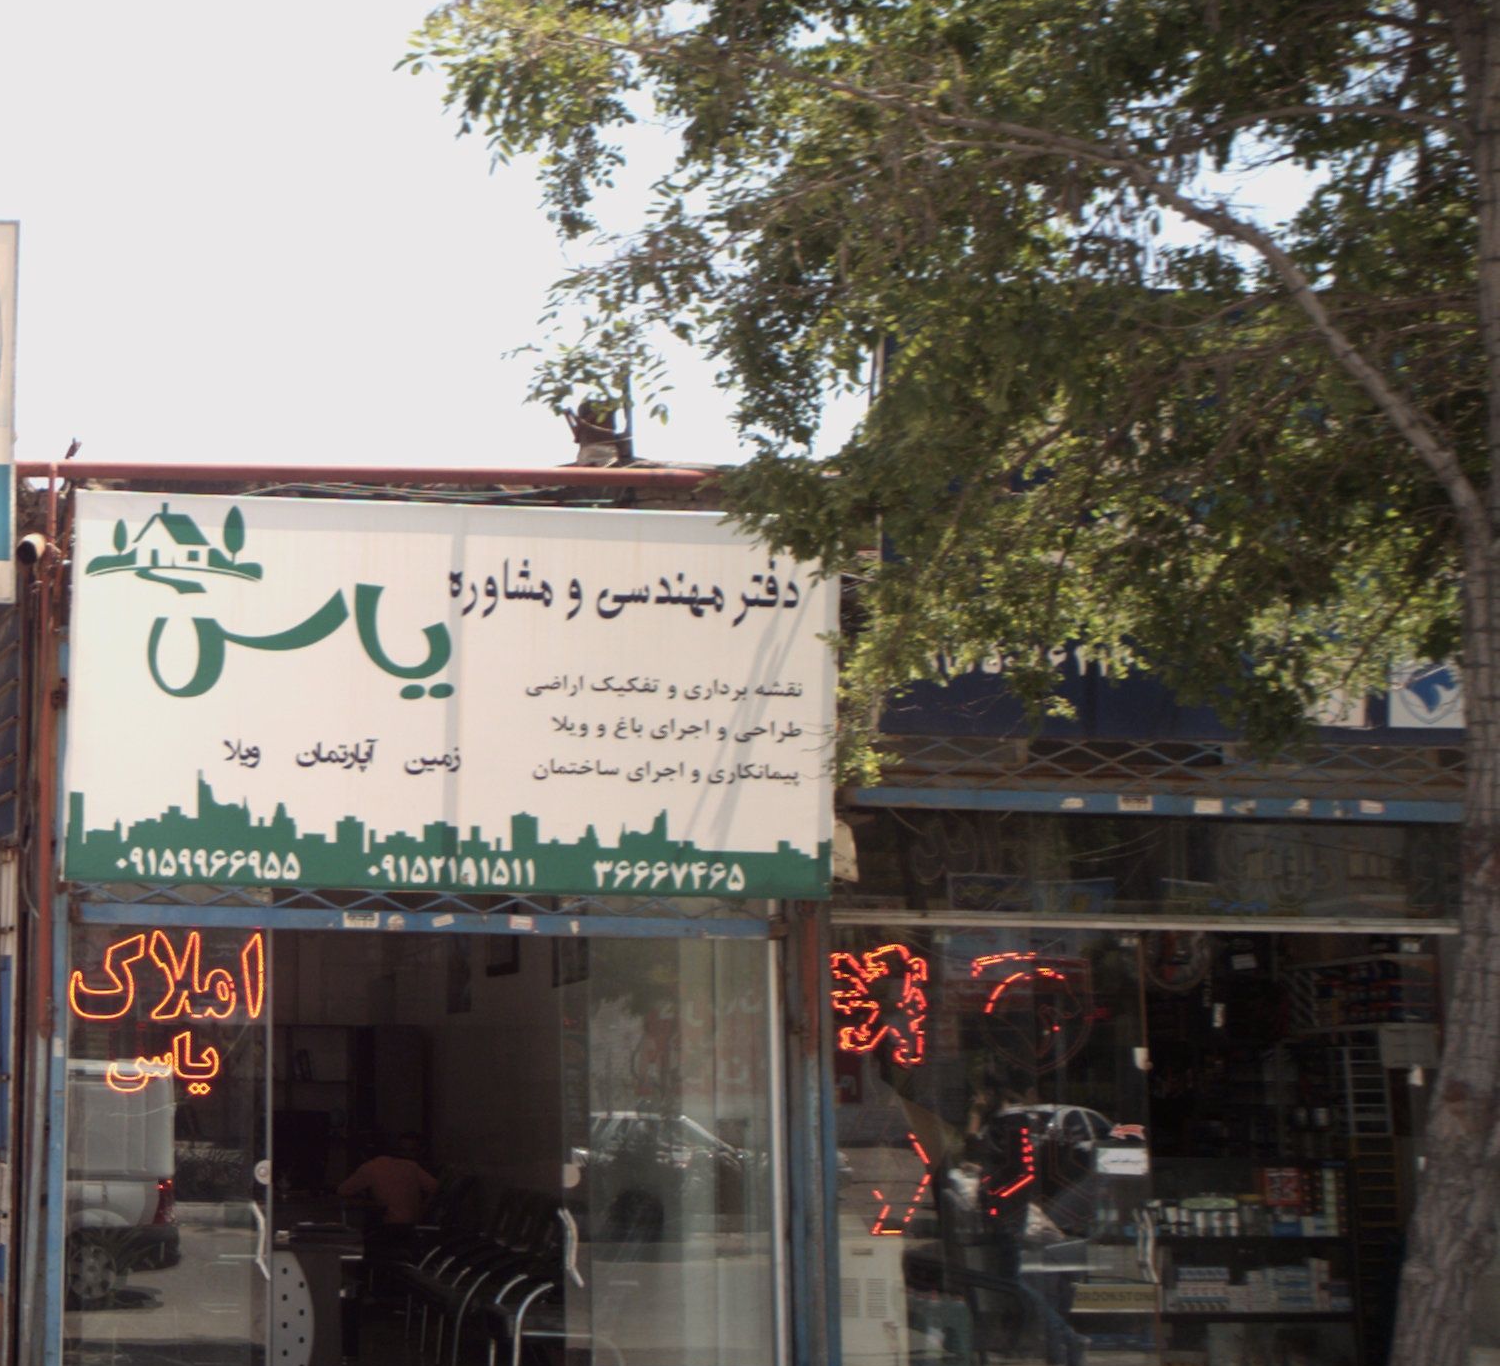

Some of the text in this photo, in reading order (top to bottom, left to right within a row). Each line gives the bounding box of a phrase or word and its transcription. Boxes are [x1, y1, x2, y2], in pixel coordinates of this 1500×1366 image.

[449, 556, 800, 627] دفتر مهندسی و مشاوره
[147, 583, 453, 700] یاس
[525, 675, 803, 701] نقشه برداری و تفکیک اراضی
[552, 715, 803, 743] طراحی و اجرای باغ و ویلا
[224, 738, 460, 775] زمین آپارتمان ویلا
[532, 757, 801, 787] پیمانکاری و اجرای ساختمان
[115, 846, 301, 881] ۰۹۱۵۹۹۶۶۹۵۵
[592, 859, 746, 892] ۳۶۶۶۷۴۶۵
[68, 929, 265, 1021] املاک
[106, 1029, 220, 1095] یاس
